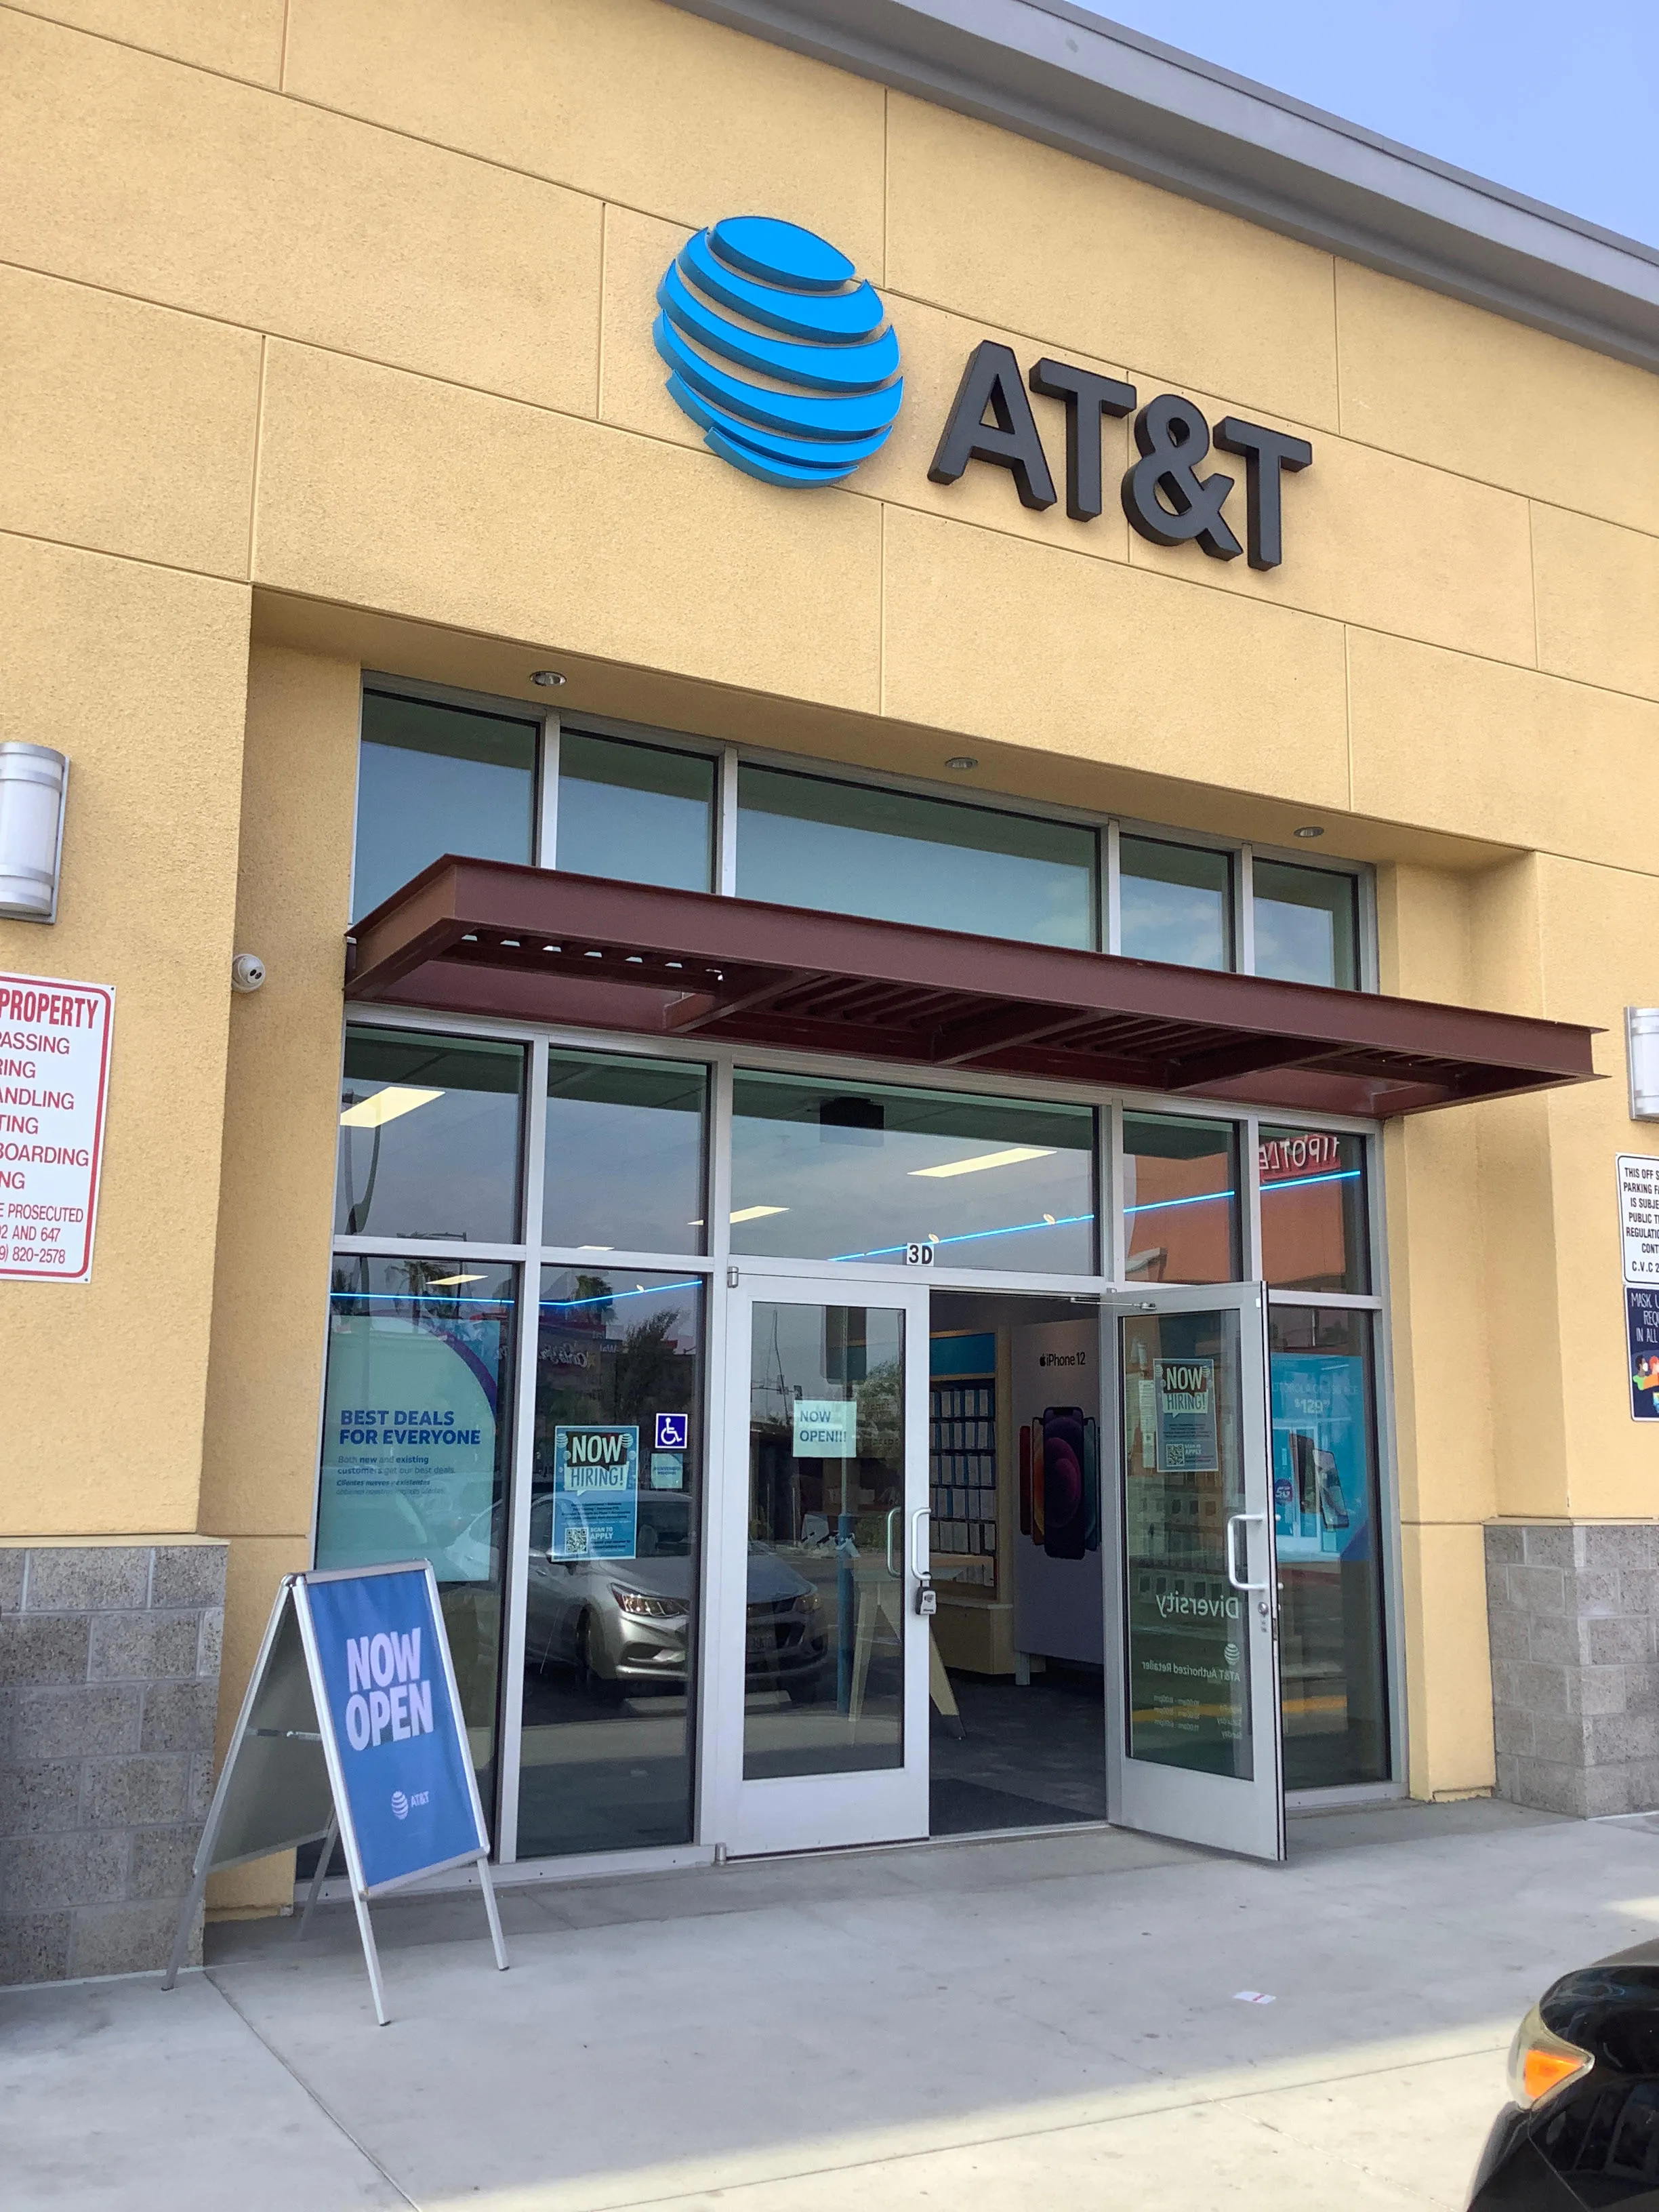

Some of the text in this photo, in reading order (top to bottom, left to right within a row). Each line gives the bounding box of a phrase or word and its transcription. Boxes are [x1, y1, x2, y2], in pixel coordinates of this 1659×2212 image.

[927, 340, 1312, 571] AT&T
[0, 988, 99, 1029] PROPERTY
[0, 1031, 70, 1054] ASSING
[0, 1059, 36, 1078] ING
[0, 1086, 75, 1109] NDLING
[1624, 1167, 1640, 1179] THIS
[1641, 1168, 1654, 1179] OFF
[1623, 1181, 1659, 1195] PARKING F
[1631, 1197, 1637, 1208] IS
[8, 1203, 84, 1223] PROSECUTED
[1629, 1212, 1652, 1224] PUBLIC
[0, 1224, 61, 1242] 2 AND 647
[12, 1246, 66, 1264] 820-2578
[909, 1244, 933, 1265] 3D
[1631, 1292, 1652, 1308] MASK
[1636, 1327, 1658, 1343] IN ALL
[1046, 1351, 1086, 1366] iPhone 12
[1166, 1366, 1203, 1391] NOW
[1167, 1394, 1206, 1411] HIRING!
[341, 1410, 455, 1426] BEST DEALS
[800, 1410, 831, 1422] NOW
[340, 1429, 480, 1445] FOR EVERYONE
[800, 1430, 846, 1443] OPEN!!!
[572, 1435, 623, 1464] NOW
[339, 1456, 357, 1464] Both
[379, 1456, 394, 1464] and
[396, 1456, 429, 1465] existing
[384, 1468, 397, 1476] get
[415, 1466, 432, 1475] best
[571, 1467, 623, 1488] HIRING!
[590, 1532, 613, 1540] APPLY
[346, 1626, 422, 1693] NOW
[346, 1680, 434, 1752] OPEN
[411, 1790, 429, 1807] AT&T
